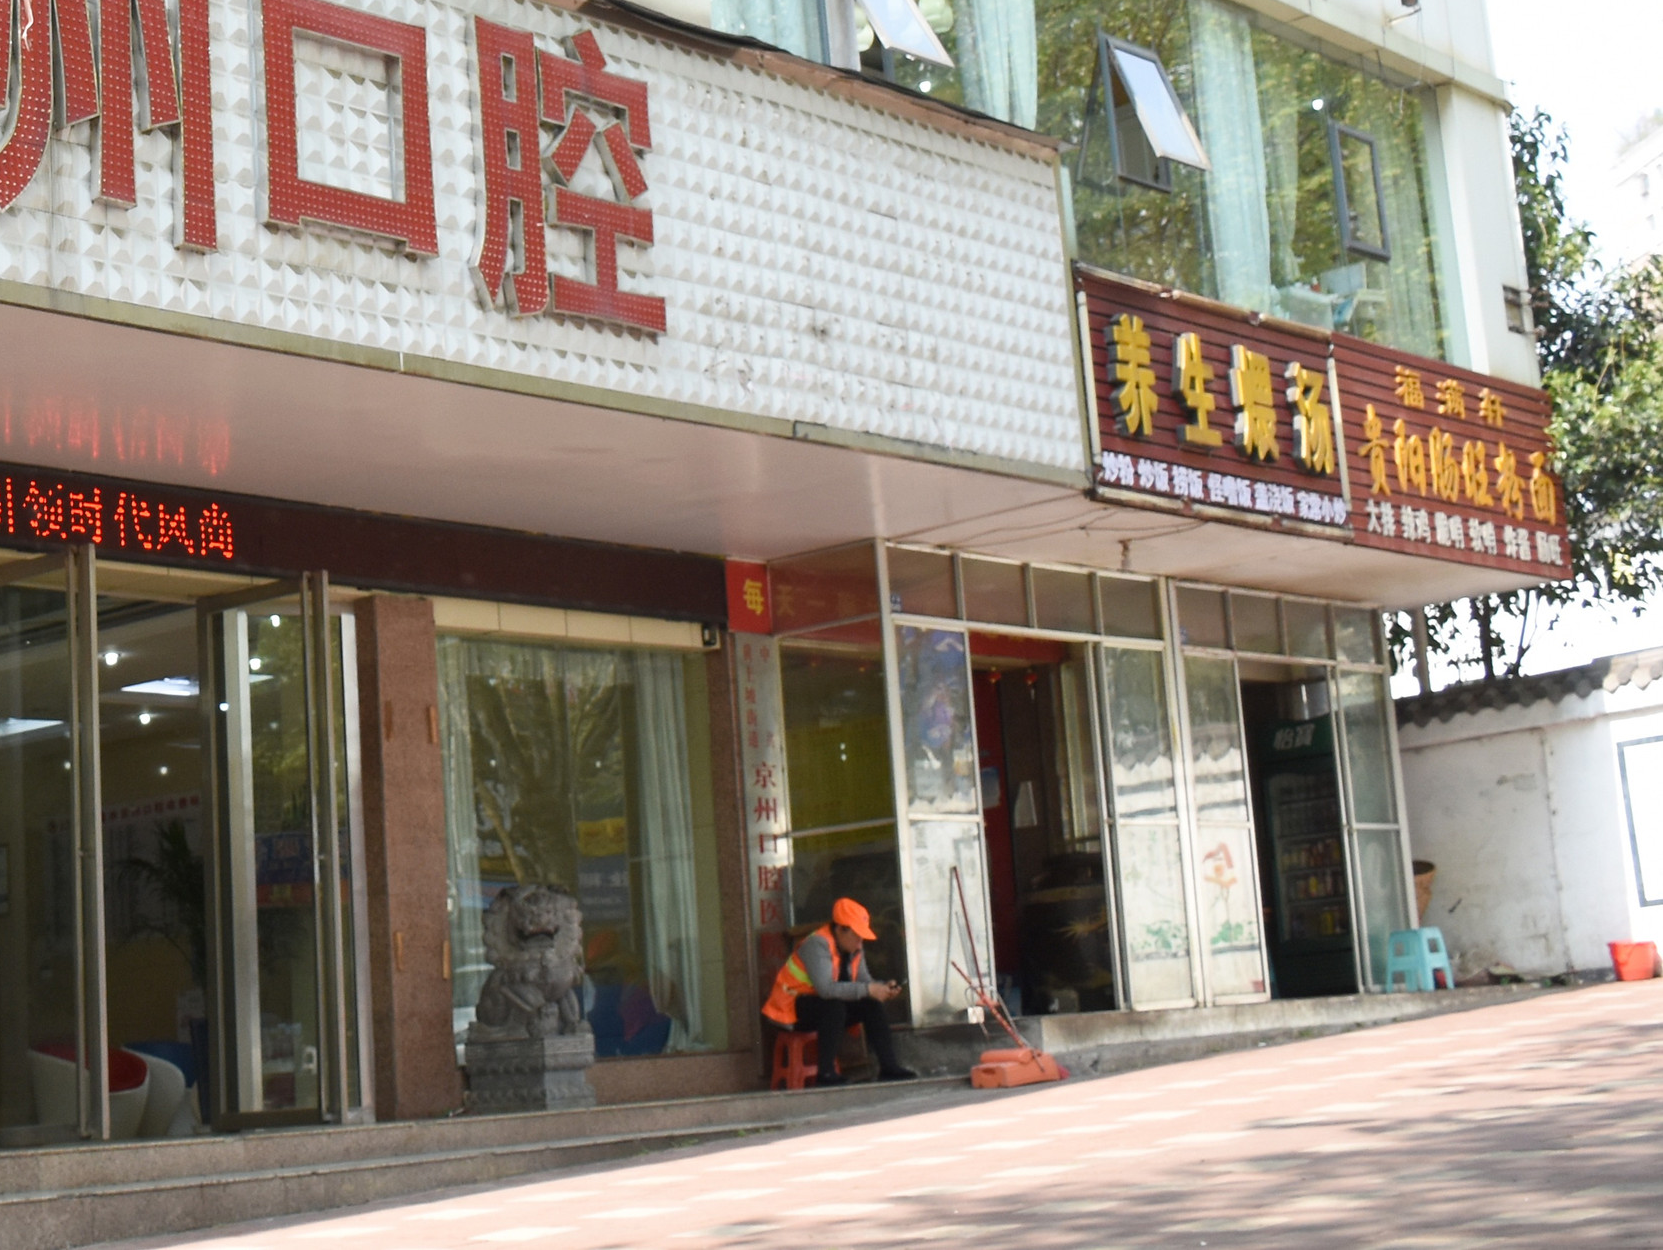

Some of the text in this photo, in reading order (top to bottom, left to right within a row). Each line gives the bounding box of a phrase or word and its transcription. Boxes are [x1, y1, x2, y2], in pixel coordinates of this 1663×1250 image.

[1103, 312, 1336, 477] 养生煨汤
[1357, 403, 1557, 527] 贵阳肠旺粉面
